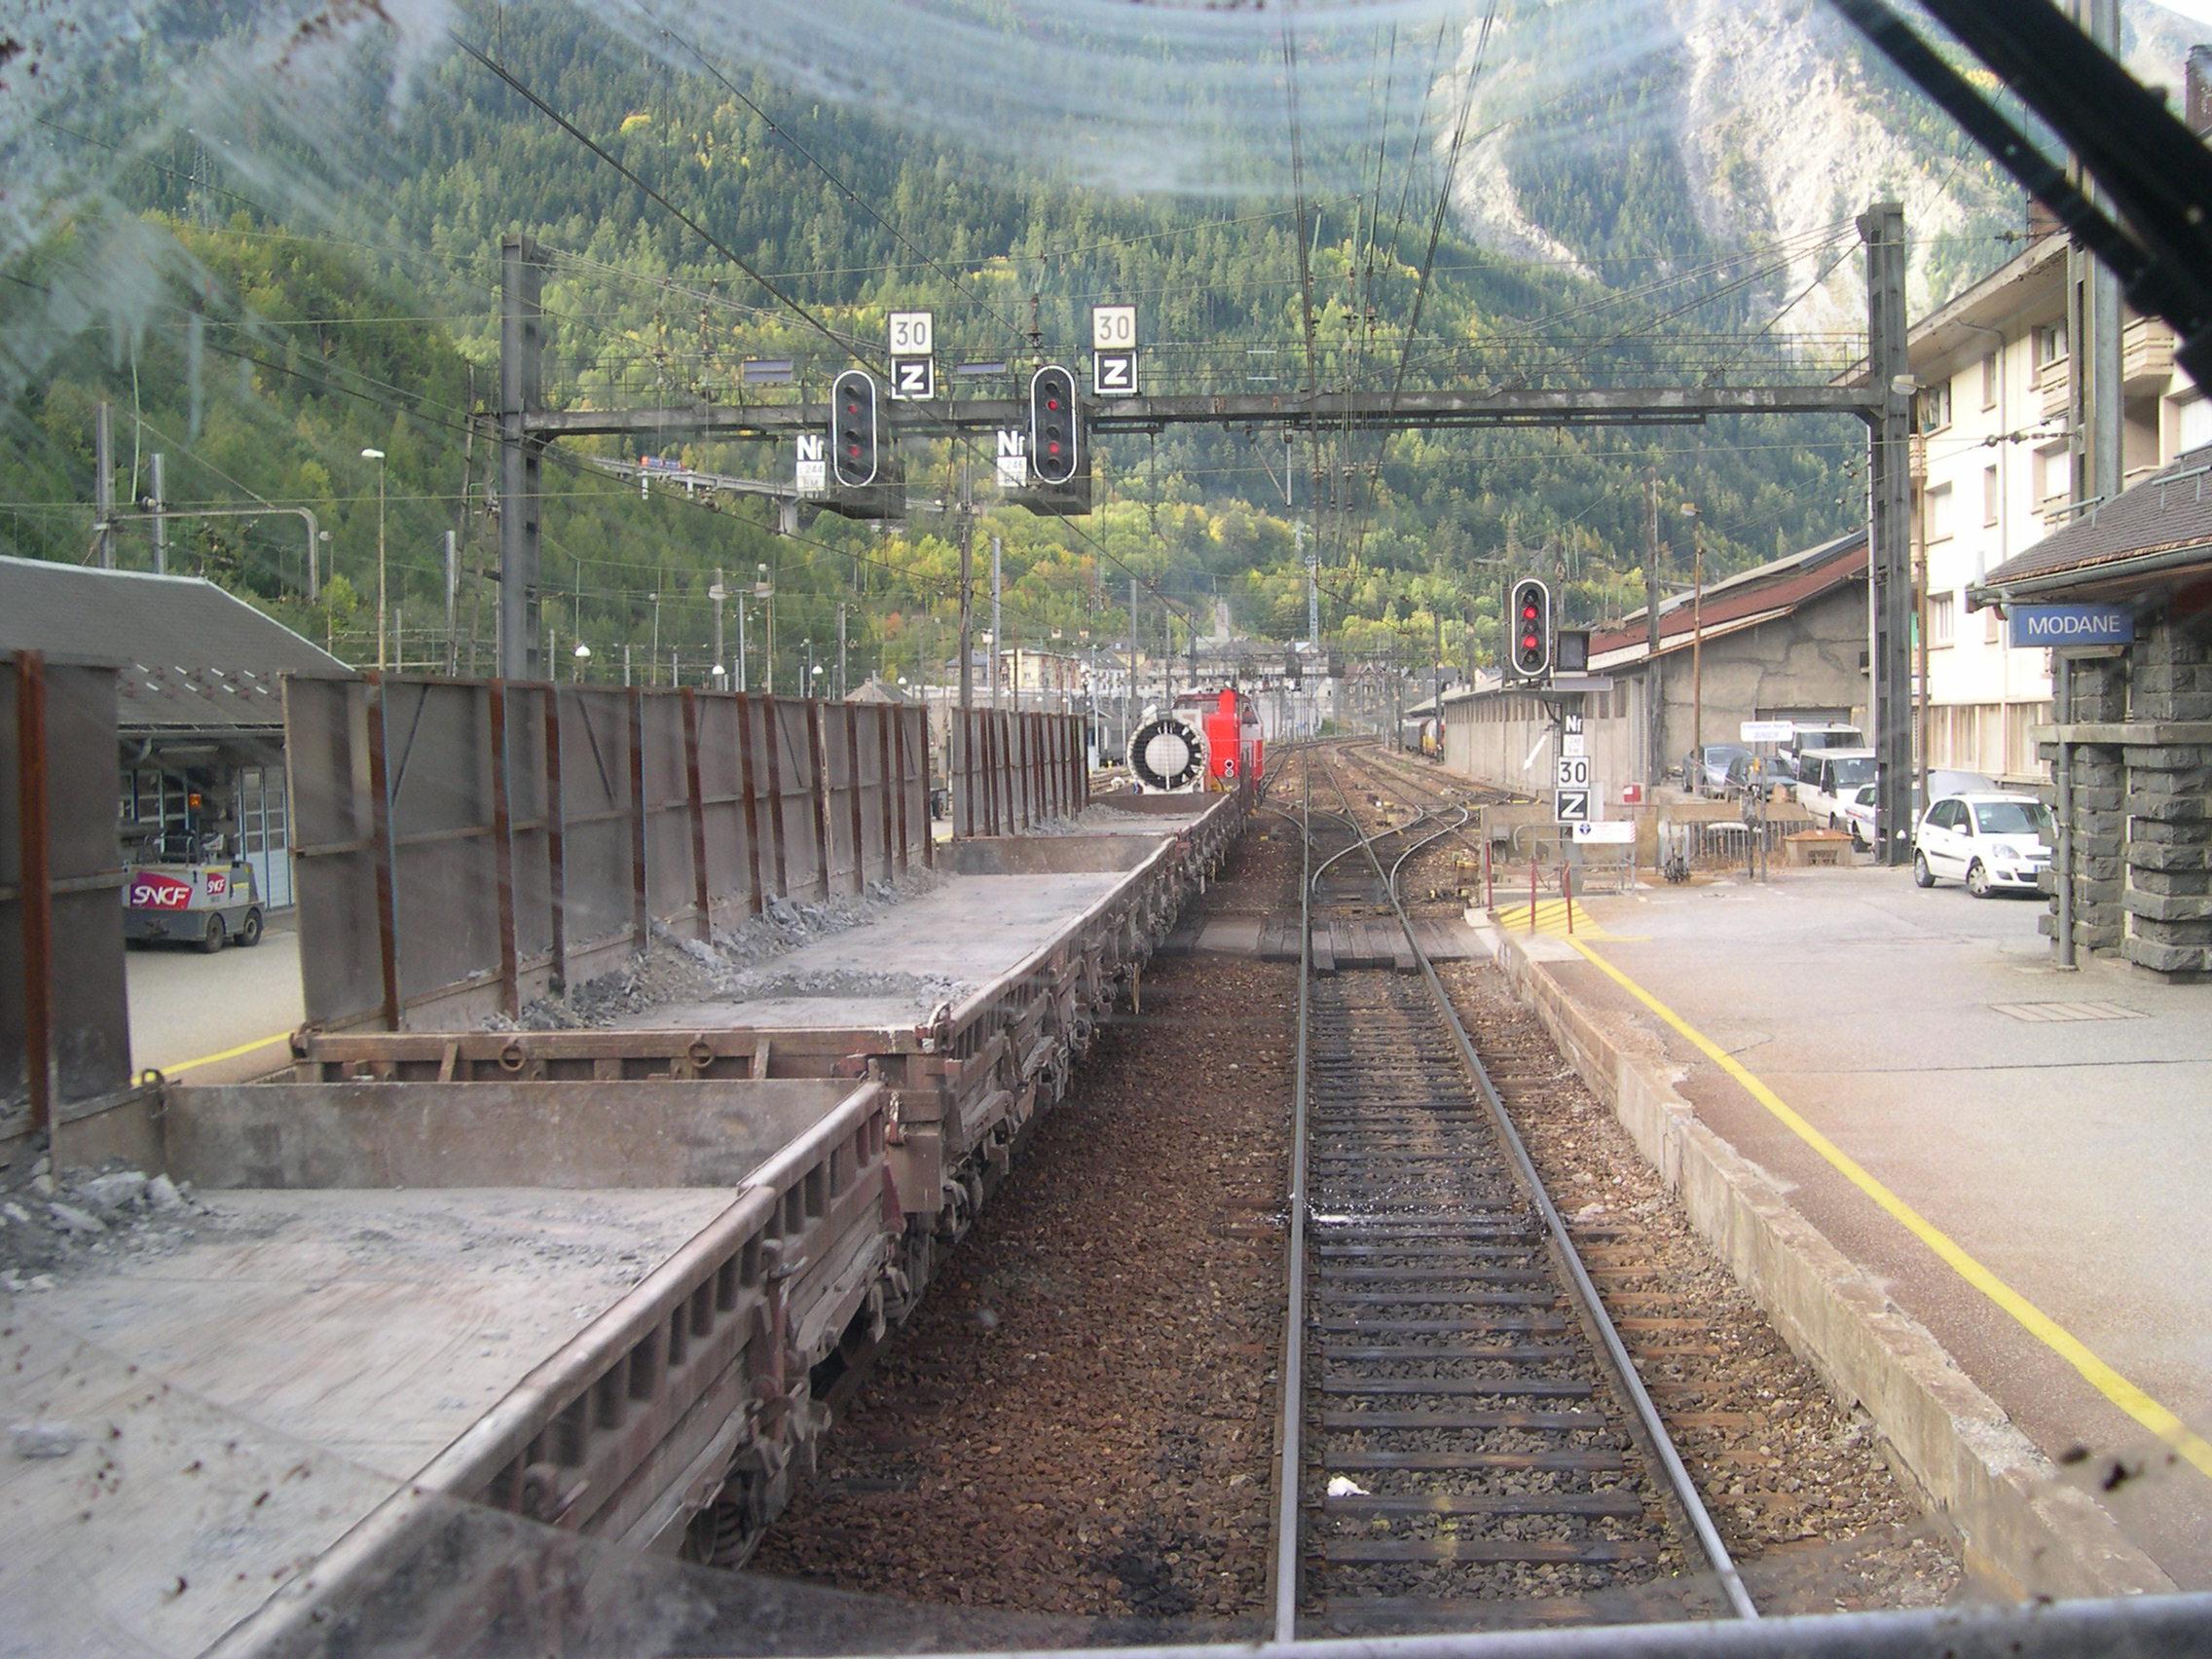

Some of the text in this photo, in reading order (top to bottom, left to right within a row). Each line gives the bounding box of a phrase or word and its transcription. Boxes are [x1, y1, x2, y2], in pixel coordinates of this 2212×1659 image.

[896, 321, 927, 346] 30
[1098, 315, 1129, 340] 30
[900, 365, 925, 390] Z
[1104, 359, 1128, 385] Z
[2028, 615, 2120, 635] MODANE
[1560, 761, 1587, 783] 30
[1561, 793, 1585, 819] Z
[131, 885, 191, 905] SNCF
